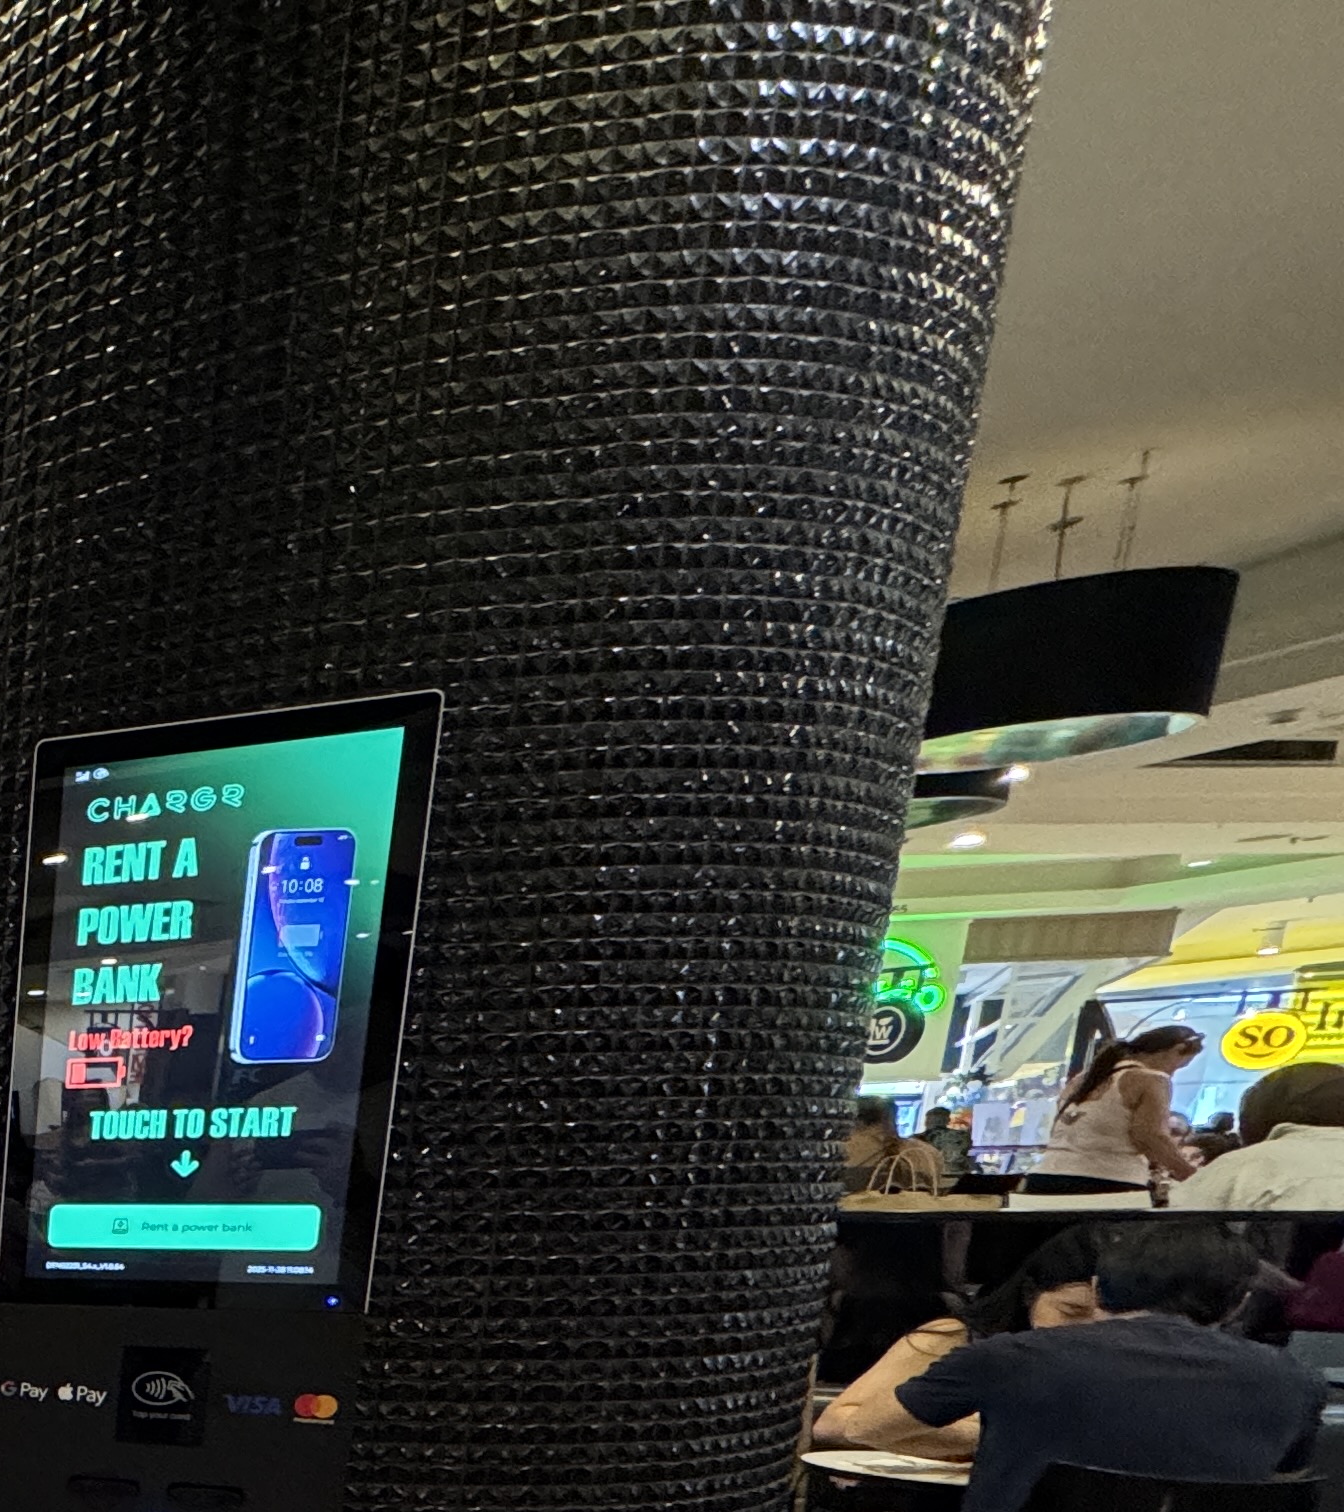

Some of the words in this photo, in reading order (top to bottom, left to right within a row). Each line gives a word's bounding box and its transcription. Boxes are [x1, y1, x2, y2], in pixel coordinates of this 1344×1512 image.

[82, 840, 167, 886] RENT
[172, 837, 199, 878] A
[282, 878, 324, 894] 10:08
[77, 900, 194, 946] POWER
[72, 963, 163, 1006] BANK
[68, 1030, 108, 1051] Low
[110, 1025, 194, 1051] Battery?
[1234, 1025, 1296, 1049] SO
[90, 1109, 167, 1140] TOUCH
[173, 1108, 205, 1139] TO
[209, 1106, 298, 1138] START
[141, 1222, 169, 1232] Rent
[181, 1224, 219, 1234] power
[222, 1223, 252, 1232] bank
[20, 1382, 49, 1402] Pay
[76, 1385, 108, 1407] Pay
[226, 1394, 282, 1416] VISA
